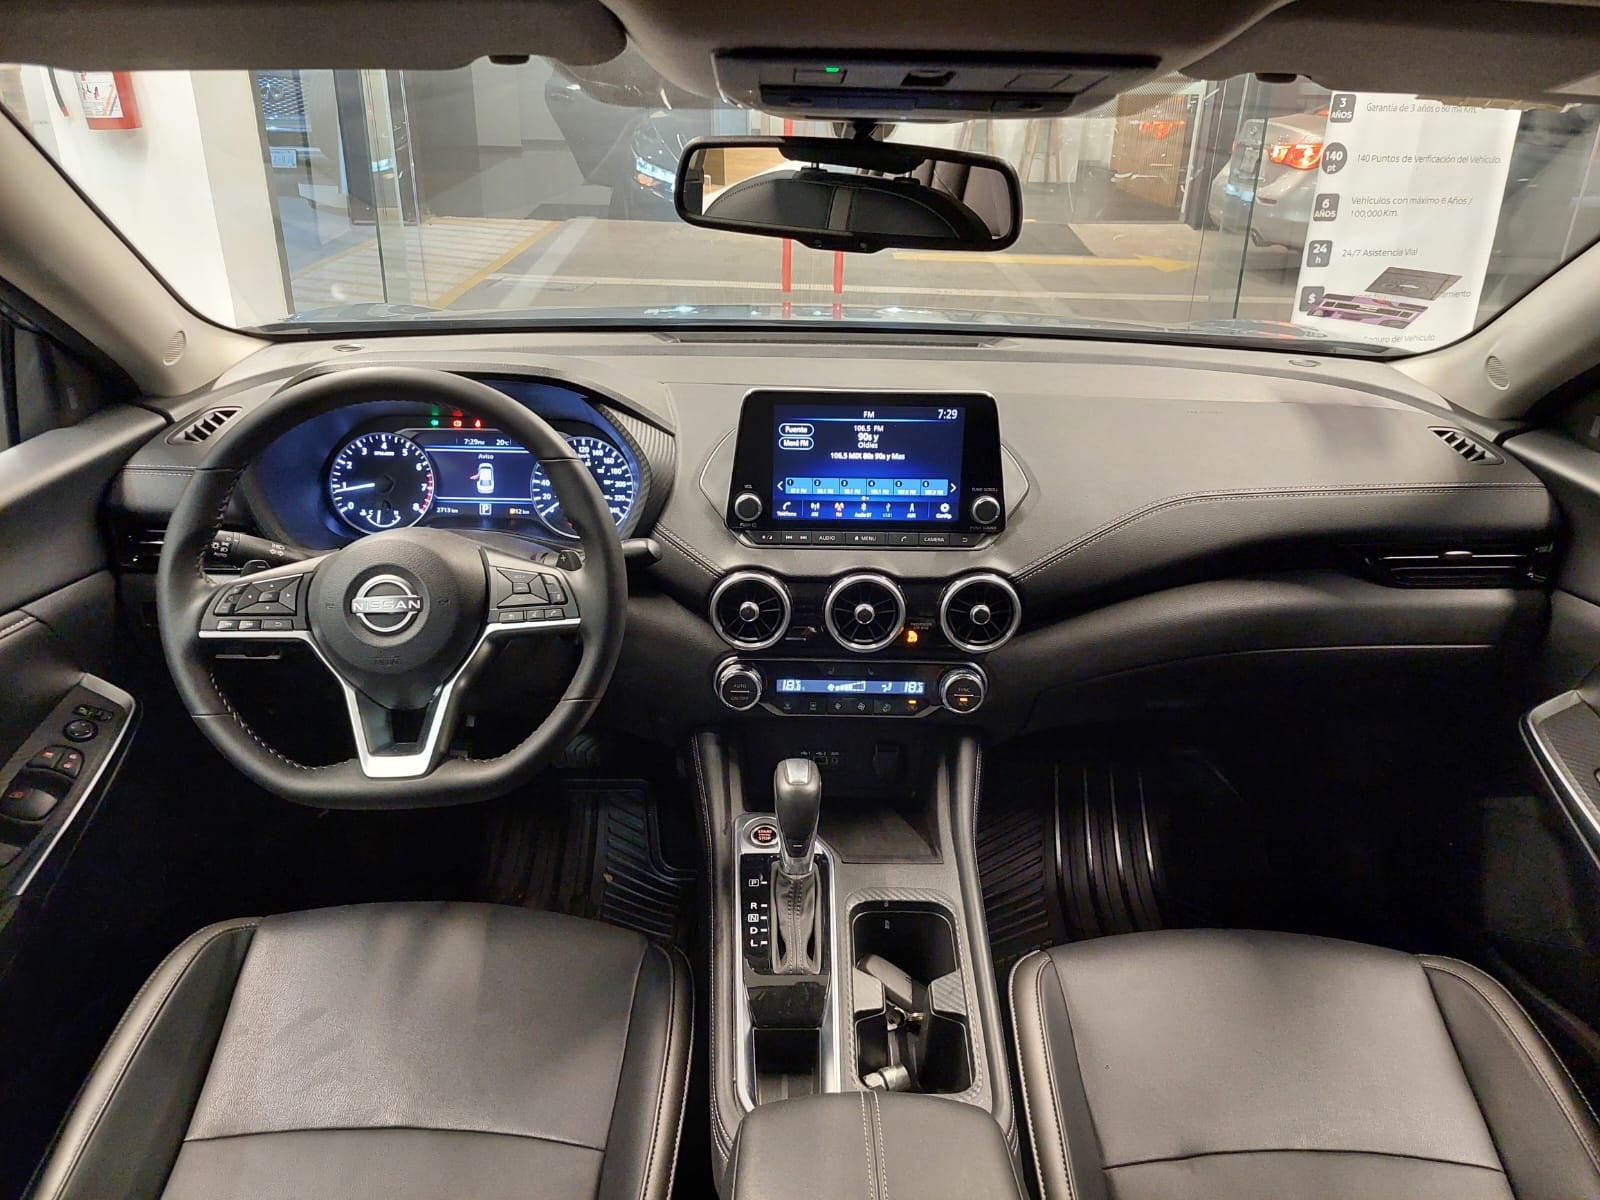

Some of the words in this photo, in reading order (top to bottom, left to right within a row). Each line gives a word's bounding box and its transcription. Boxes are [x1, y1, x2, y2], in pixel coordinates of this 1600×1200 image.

[1339, 97, 1347, 108] 3
[1399, 103, 1409, 112] de
[1410, 103, 1416, 112] 3
[1417, 102, 1433, 112] años
[1331, 109, 1352, 119] AÑOS
[1325, 151, 1343, 161] 140
[1357, 154, 1371, 163] 140
[1371, 154, 1400, 163] Puntos
[1402, 154, 1413, 163] de
[1456, 154, 1469, 163] del
[1327, 164, 1336, 174] pt
[1322, 198, 1330, 209] 6
[1392, 197, 1408, 205] con
[1440, 196, 1447, 205] 6
[1314, 207, 1336, 218] AÑOS
[1313, 243, 1327, 254] 24
[1341, 249, 1361, 258] 24/7
[1362, 249, 1404, 257] Asistencia
[1315, 256, 1322, 264] h
[863, 410, 875, 419] FM
[937, 409, 958, 420] 7:29
[853, 424, 871, 432] 106.5
[857, 432, 873, 441] 90s
[873, 433, 879, 443] y
[381, 442, 388, 450] 4
[361, 447, 368, 456] 3
[402, 448, 408, 457] 5
[346, 461, 353, 470] 2
[416, 463, 422, 471] 6
[420, 483, 427, 492] 7
[540, 480, 551, 488] 40
[352, 599, 421, 611] NISSAN
[750, 902, 758, 910] R
[749, 926, 759, 935] D
[750, 939, 759, 947] L
